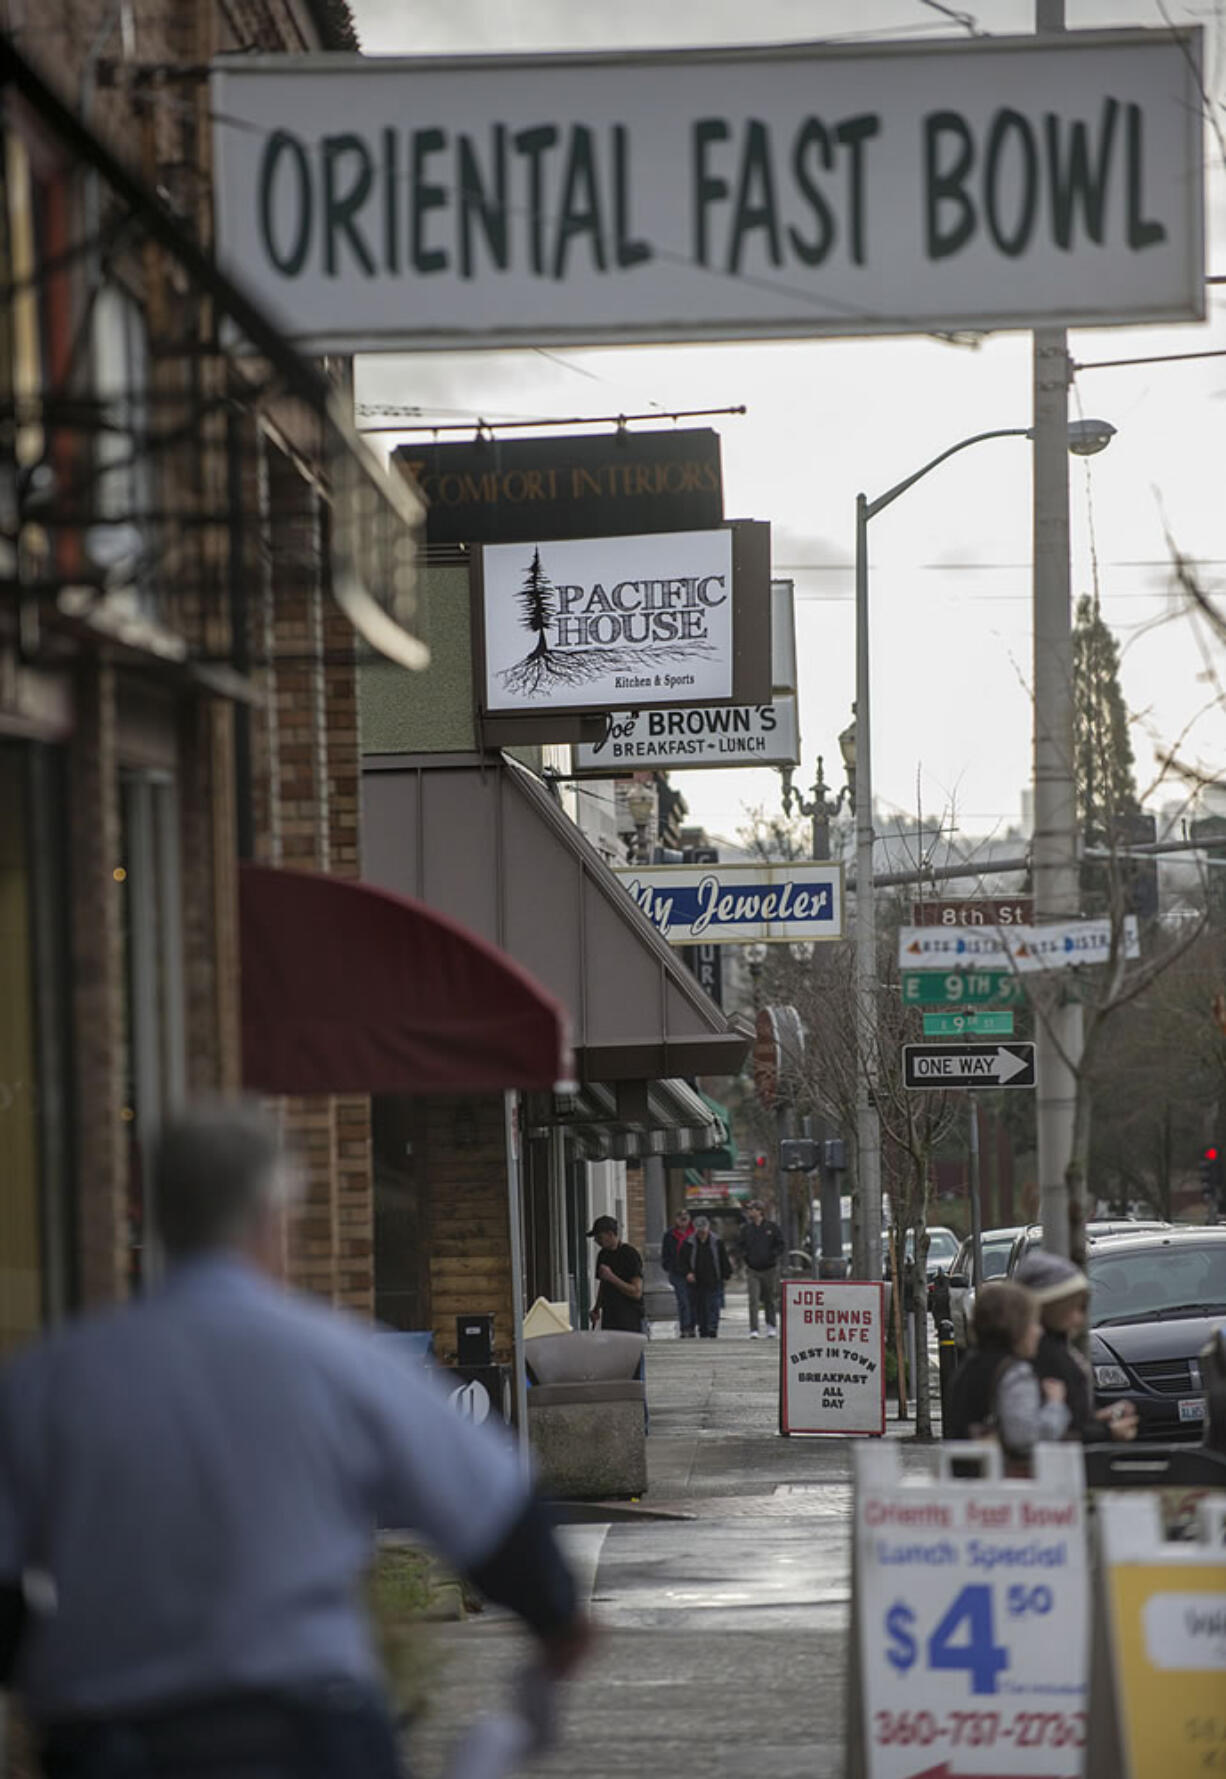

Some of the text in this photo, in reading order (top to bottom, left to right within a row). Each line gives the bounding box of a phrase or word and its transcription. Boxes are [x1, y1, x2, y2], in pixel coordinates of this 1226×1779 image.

[257, 95, 1168, 282] ORIENTAL FAST BOWL
[571, 459, 719, 498] INTERIORS
[556, 575, 726, 615] PACIFIC
[556, 609, 707, 647] HOUSE
[615, 674, 696, 689] Kitchen & Sports
[649, 704, 777, 736] BROWN'S
[613, 739, 706, 758] BREAKFAST
[719, 736, 766, 753] LUNCH
[627, 874, 828, 937] My Jeweler
[942, 906, 1024, 926] 8th St
[907, 977, 920, 998] E
[945, 974, 990, 1000] 9TH
[918, 1057, 995, 1075] ONE WAY
[793, 1291, 825, 1306] JOE
[804, 1310, 872, 1325] BROWNS
[826, 1328, 870, 1343] CAFE
[790, 1347, 877, 1373] BEST IN TOWN
[798, 1372, 868, 1384] BREAKFAST
[823, 1387, 844, 1397] ALL
[822, 1398, 845, 1409] DAY
[966, 1538, 1067, 1571] Special
